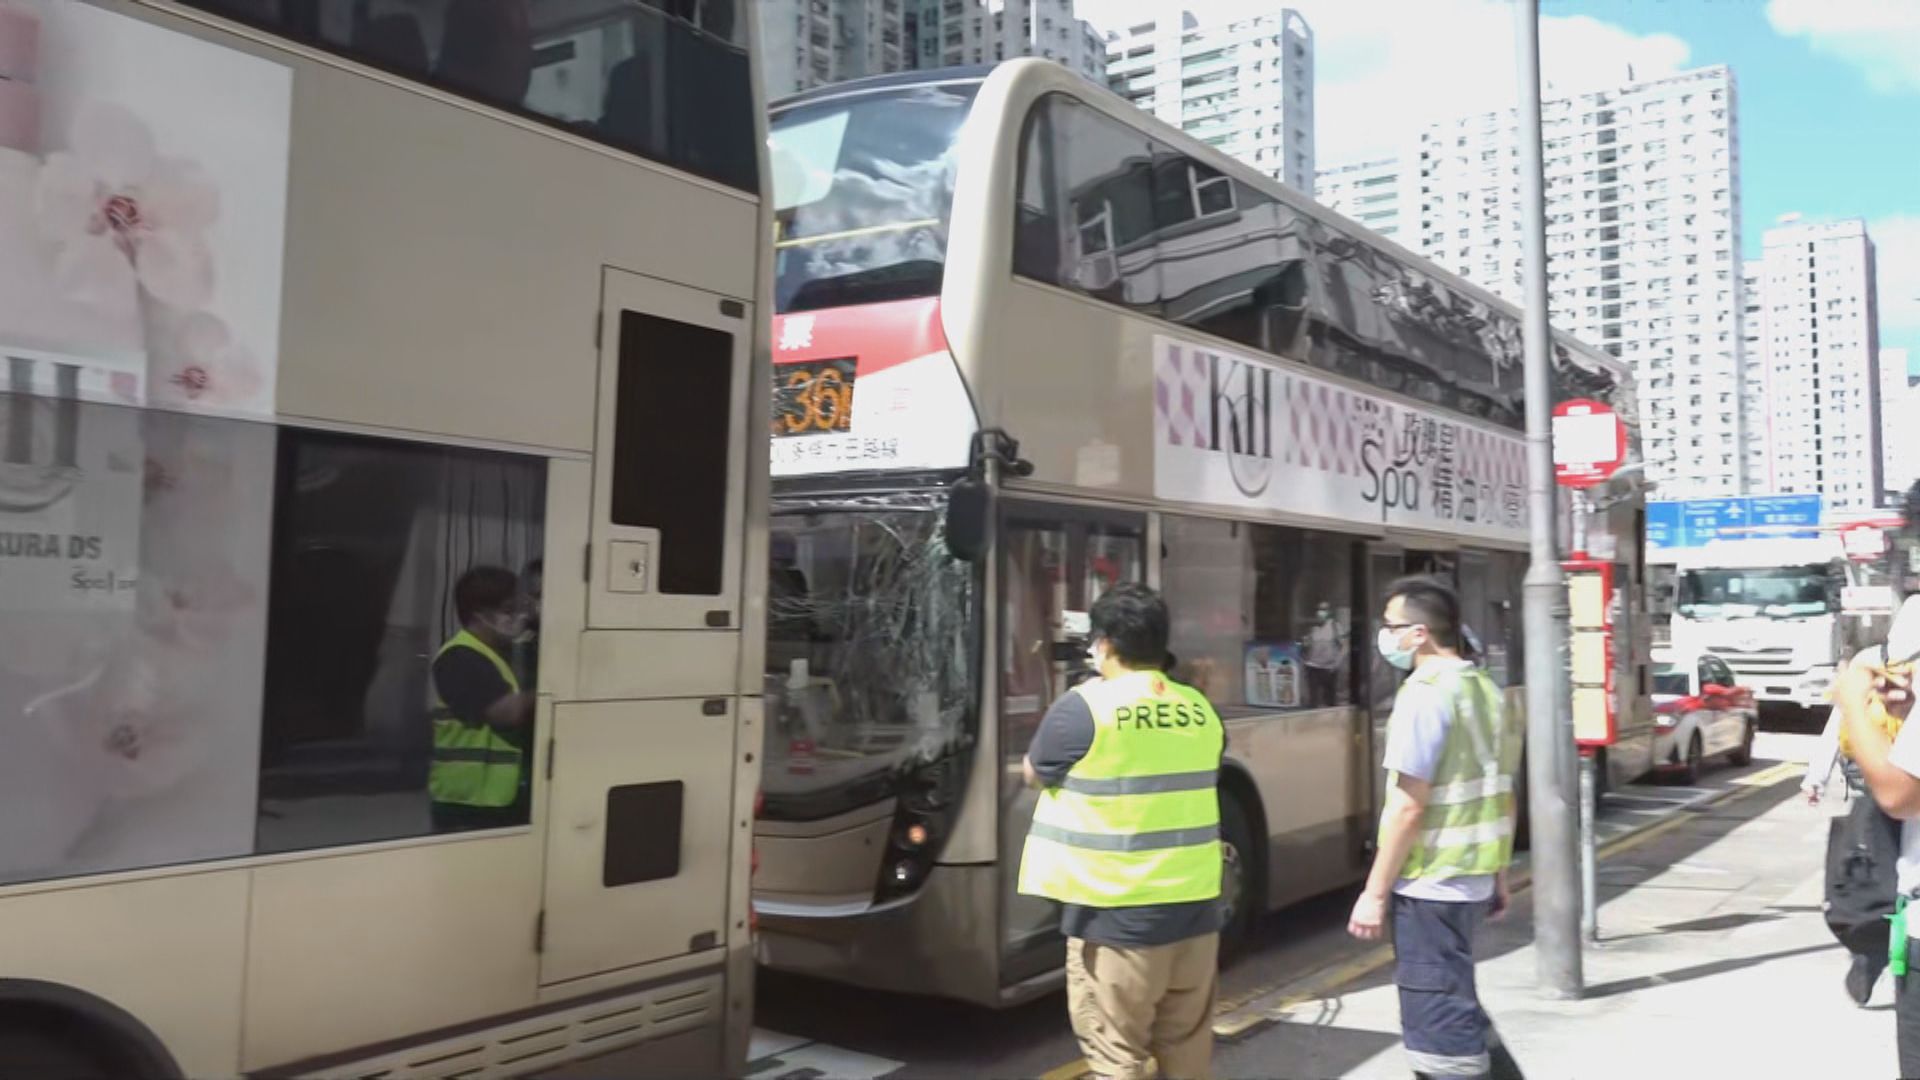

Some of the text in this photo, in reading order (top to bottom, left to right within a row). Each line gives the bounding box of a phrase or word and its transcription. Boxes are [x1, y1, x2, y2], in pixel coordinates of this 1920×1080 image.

[1361, 437, 1419, 522] Spa
[69, 535, 102, 560] DS
[1116, 703, 1207, 731] PRESS
